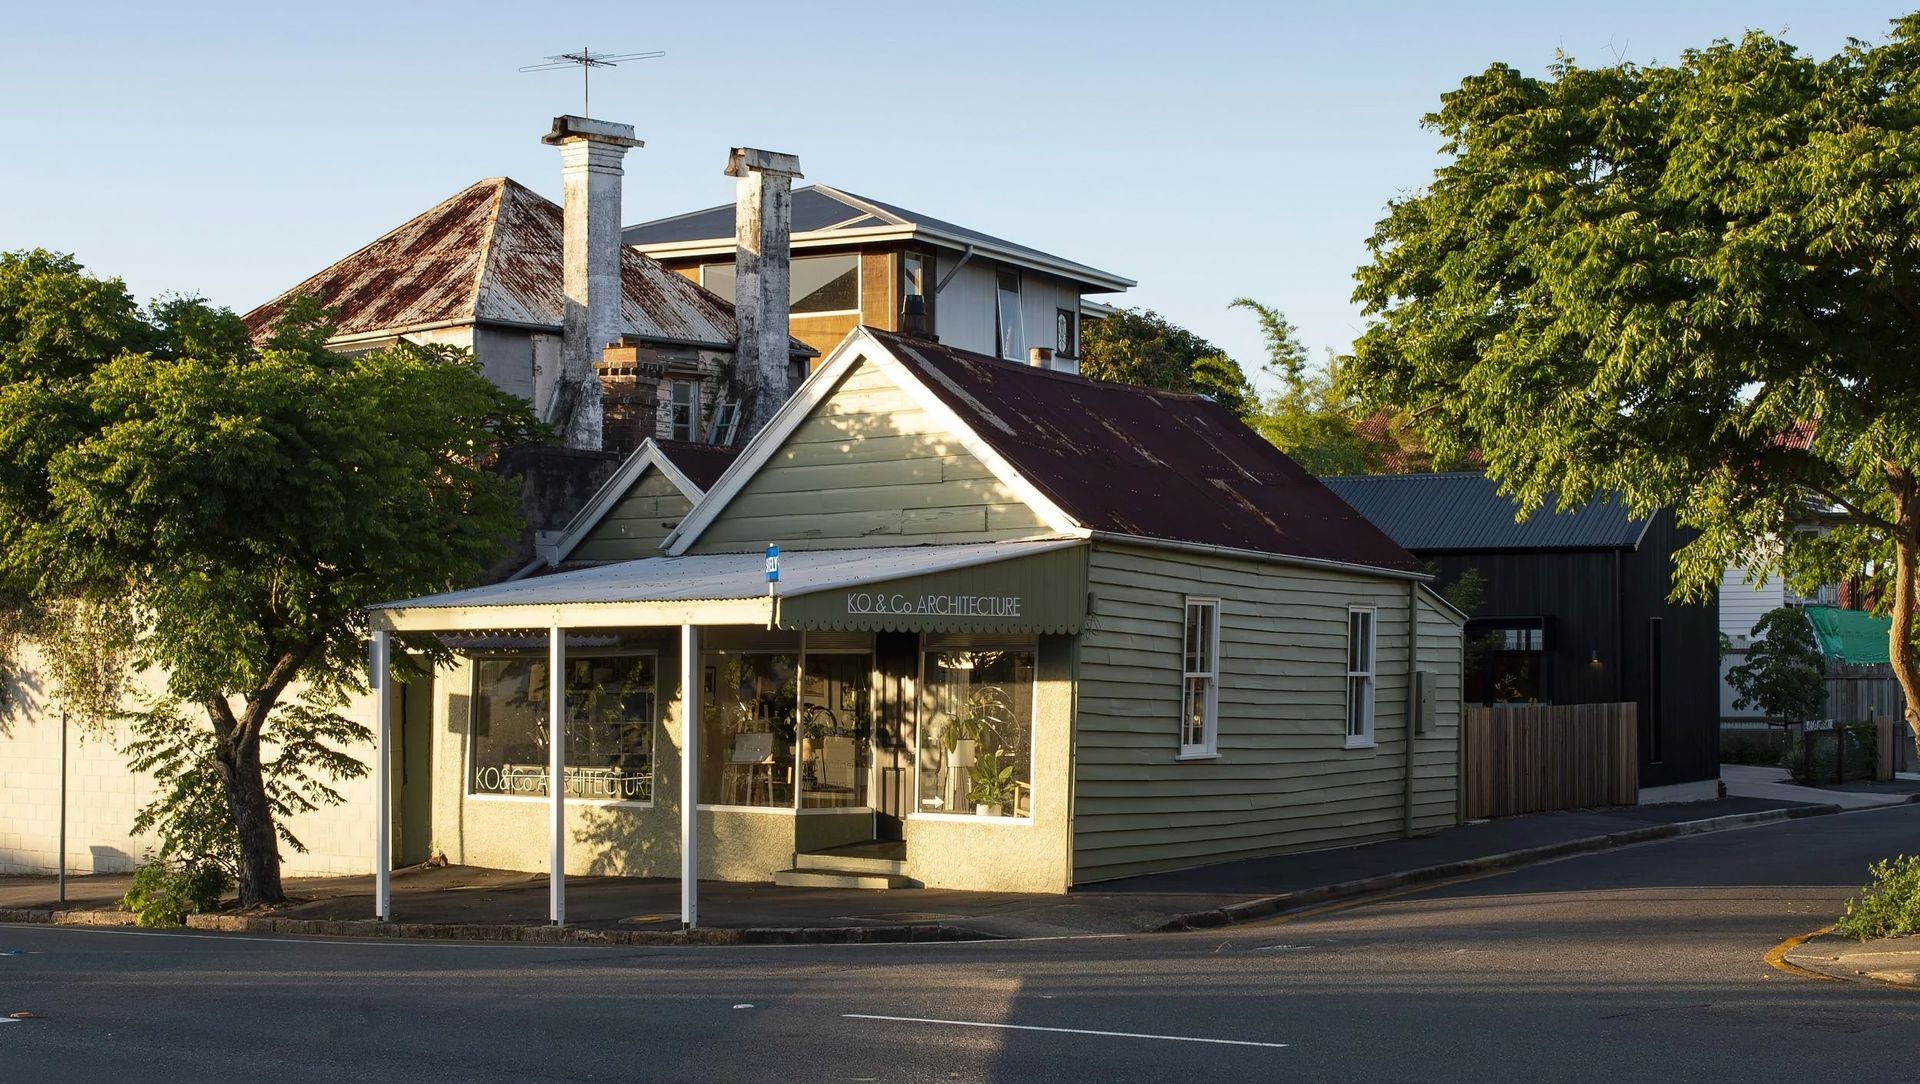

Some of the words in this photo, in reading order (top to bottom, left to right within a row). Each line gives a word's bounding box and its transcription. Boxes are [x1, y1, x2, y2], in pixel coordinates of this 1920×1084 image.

[848, 593, 871, 613] KO
[875, 594, 886, 613] &
[891, 594, 912, 613] Co
[917, 595, 1020, 615] ARCHITECTURE
[537, 769, 653, 795] AHITECTURE
